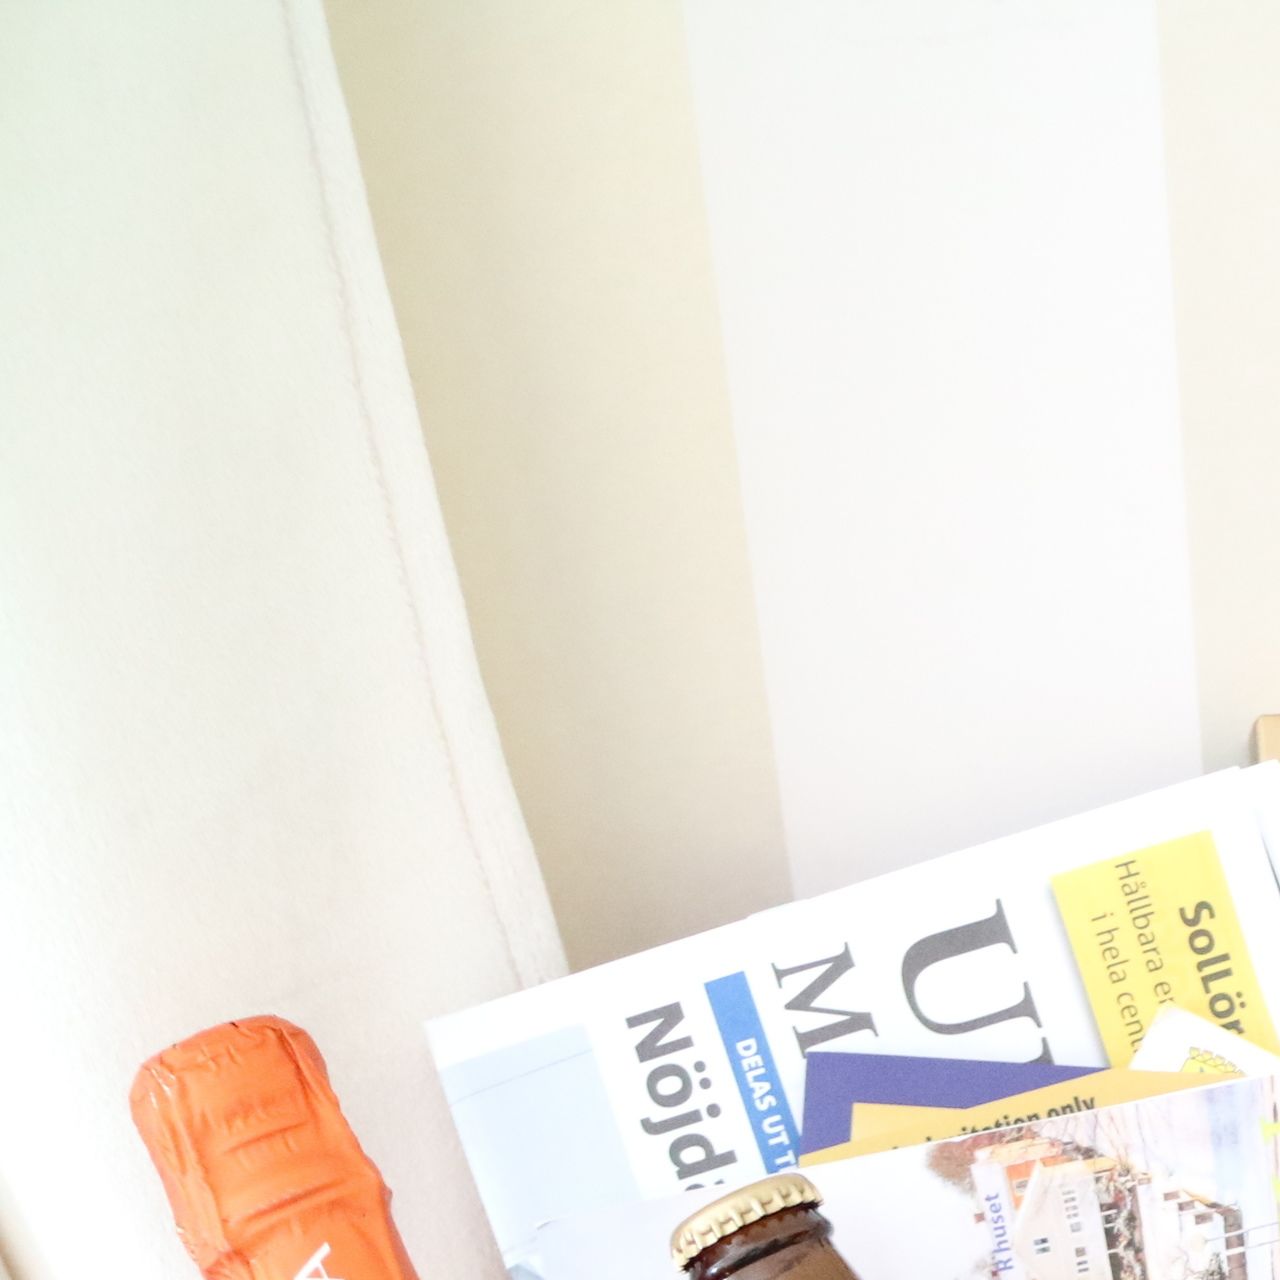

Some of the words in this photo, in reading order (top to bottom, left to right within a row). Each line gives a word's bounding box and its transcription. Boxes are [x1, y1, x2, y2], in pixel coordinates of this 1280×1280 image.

[1091, 913, 1114, 921] i
[1096, 927, 1130, 984] hela
[1115, 860, 1164, 972] Hållbara
[625, 1001, 739, 1191] Nöjd
[734, 1036, 777, 1112] DELAS
[761, 1114, 786, 1152] UT
